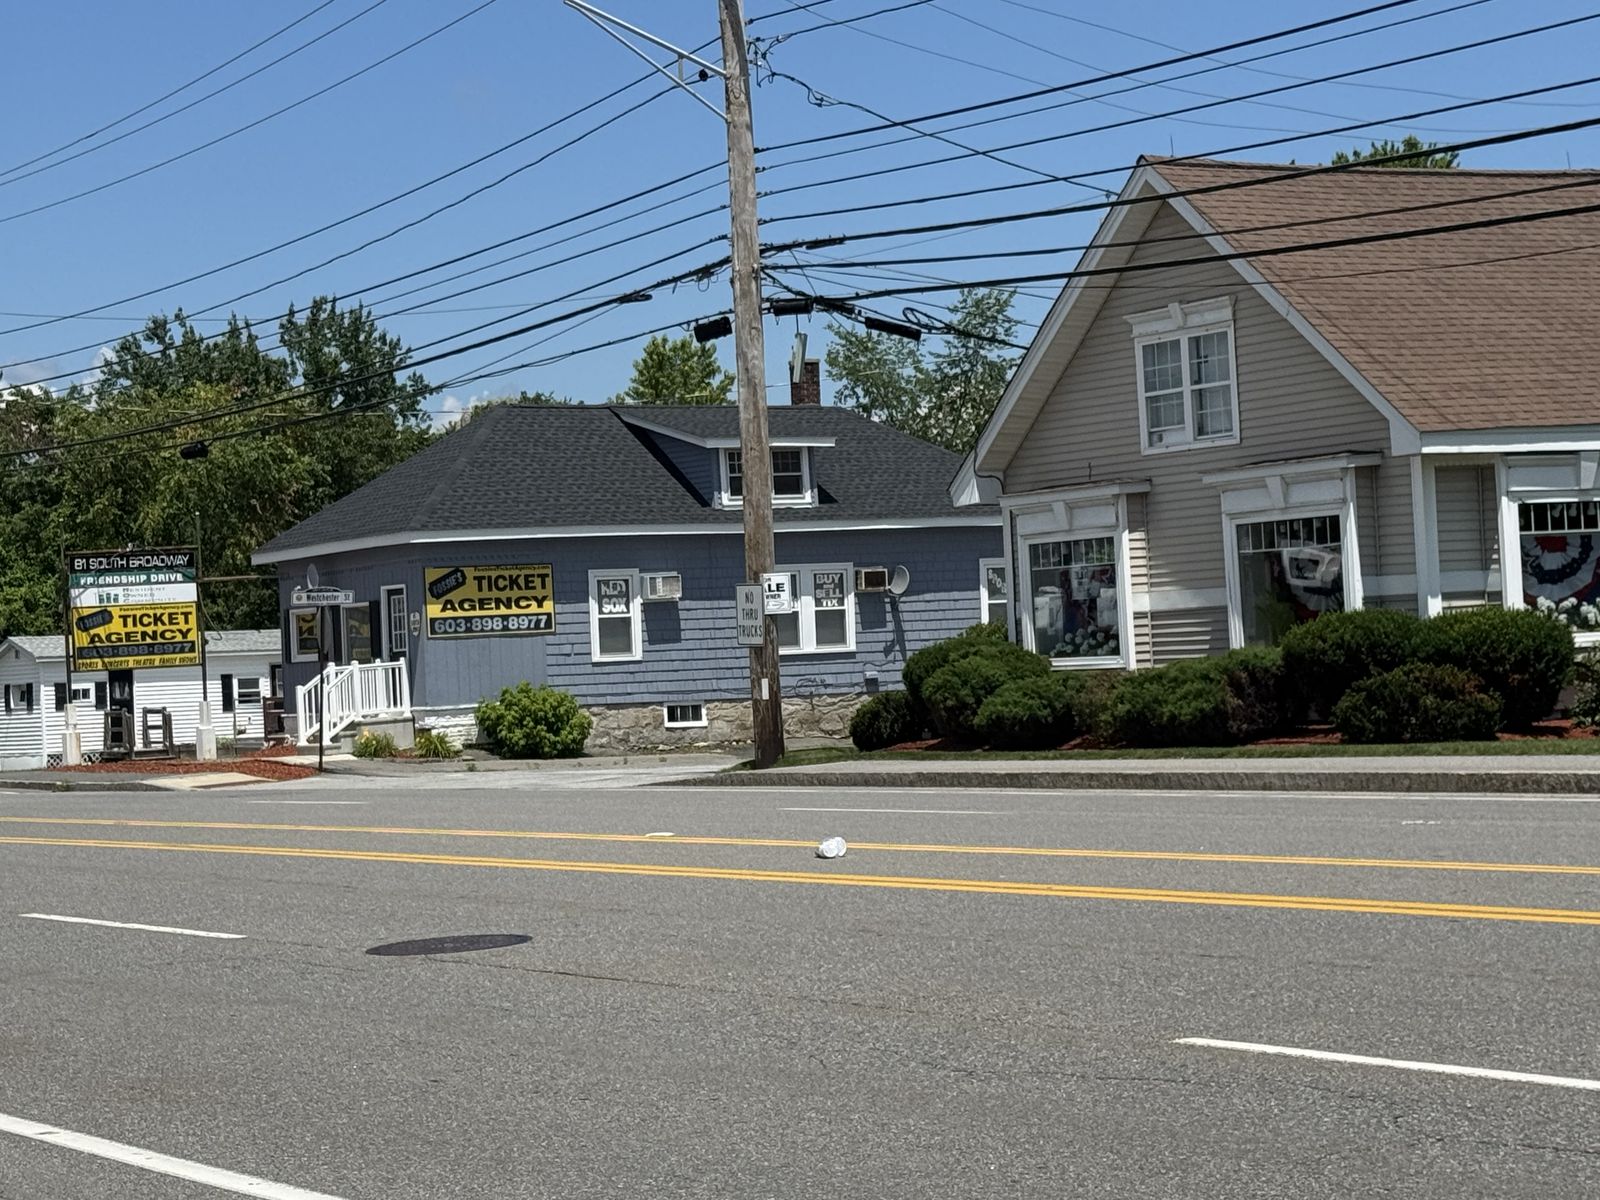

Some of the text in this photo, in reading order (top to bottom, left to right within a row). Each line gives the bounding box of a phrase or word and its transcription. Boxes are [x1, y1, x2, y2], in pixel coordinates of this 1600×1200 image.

[74, 554, 190, 570] 81 SOUTH BROADWAY
[80, 573, 184, 586] FRIENDSHIP DRIVE
[473, 573, 550, 592] TICKET
[816, 574, 841, 584] BUY
[764, 583, 786, 593] LE
[816, 588, 843, 598] SELL
[306, 593, 340, 602] Westchester
[440, 595, 549, 613] AGENCY
[745, 591, 754, 604] NO
[602, 597, 628, 613] SOX
[118, 611, 193, 628] TICKET
[742, 608, 759, 621] THRU
[88, 628, 194, 645] AGENCY
[739, 624, 763, 638] TRUCKS
